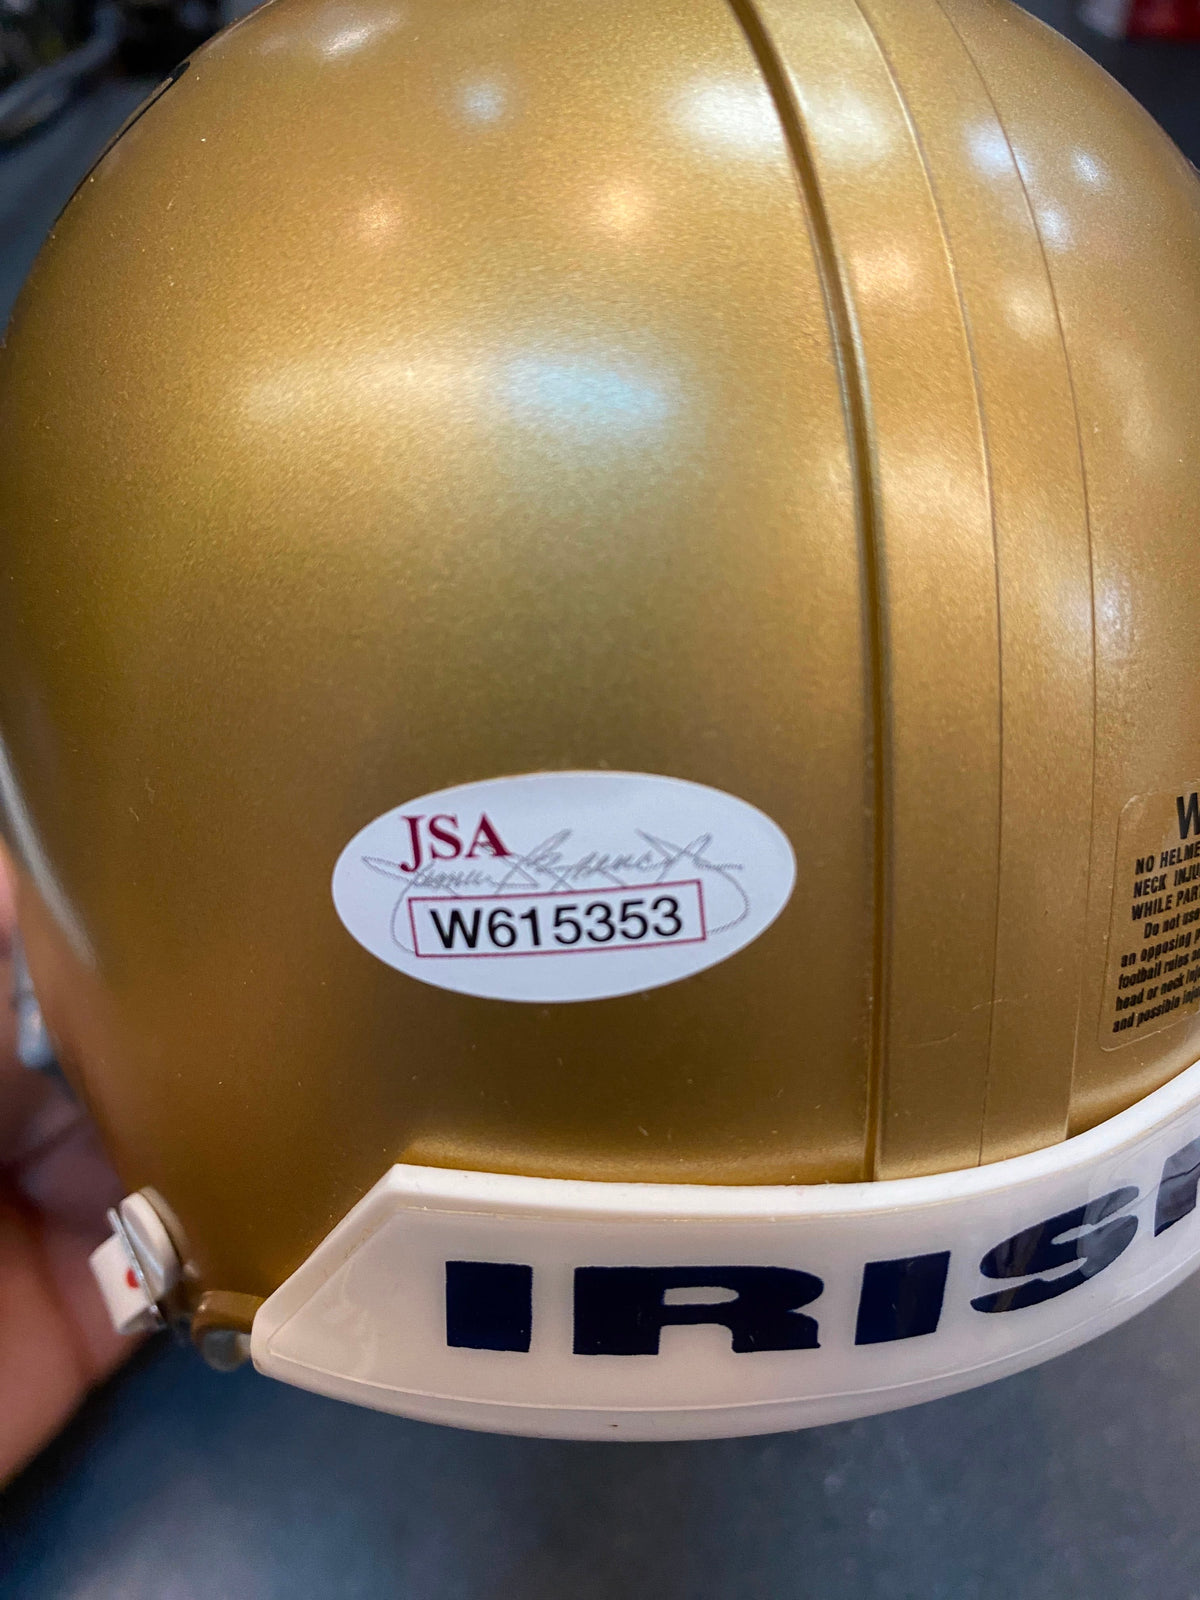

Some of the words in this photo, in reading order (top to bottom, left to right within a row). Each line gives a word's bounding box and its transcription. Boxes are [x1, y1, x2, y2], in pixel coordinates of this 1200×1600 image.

[399, 812, 511, 872] JSA
[1135, 855, 1155, 875] NO
[1131, 894, 1173, 920] WHILE
[1176, 884, 1200, 907] PAR
[1133, 873, 1167, 898] NECK
[429, 896, 683, 949] W615353
[1144, 922, 1160, 939] Do
[1162, 913, 1180, 933] not
[1121, 952, 1137, 968] an
[1140, 931, 1192, 962] opposing
[1118, 961, 1162, 990] football
[1163, 953, 1189, 974] rules
[1115, 988, 1144, 1012] head
[1147, 986, 1159, 1000] or
[1160, 973, 1185, 996] neck
[1112, 1012, 1135, 1033] and
[1136, 995, 1180, 1028] possible
